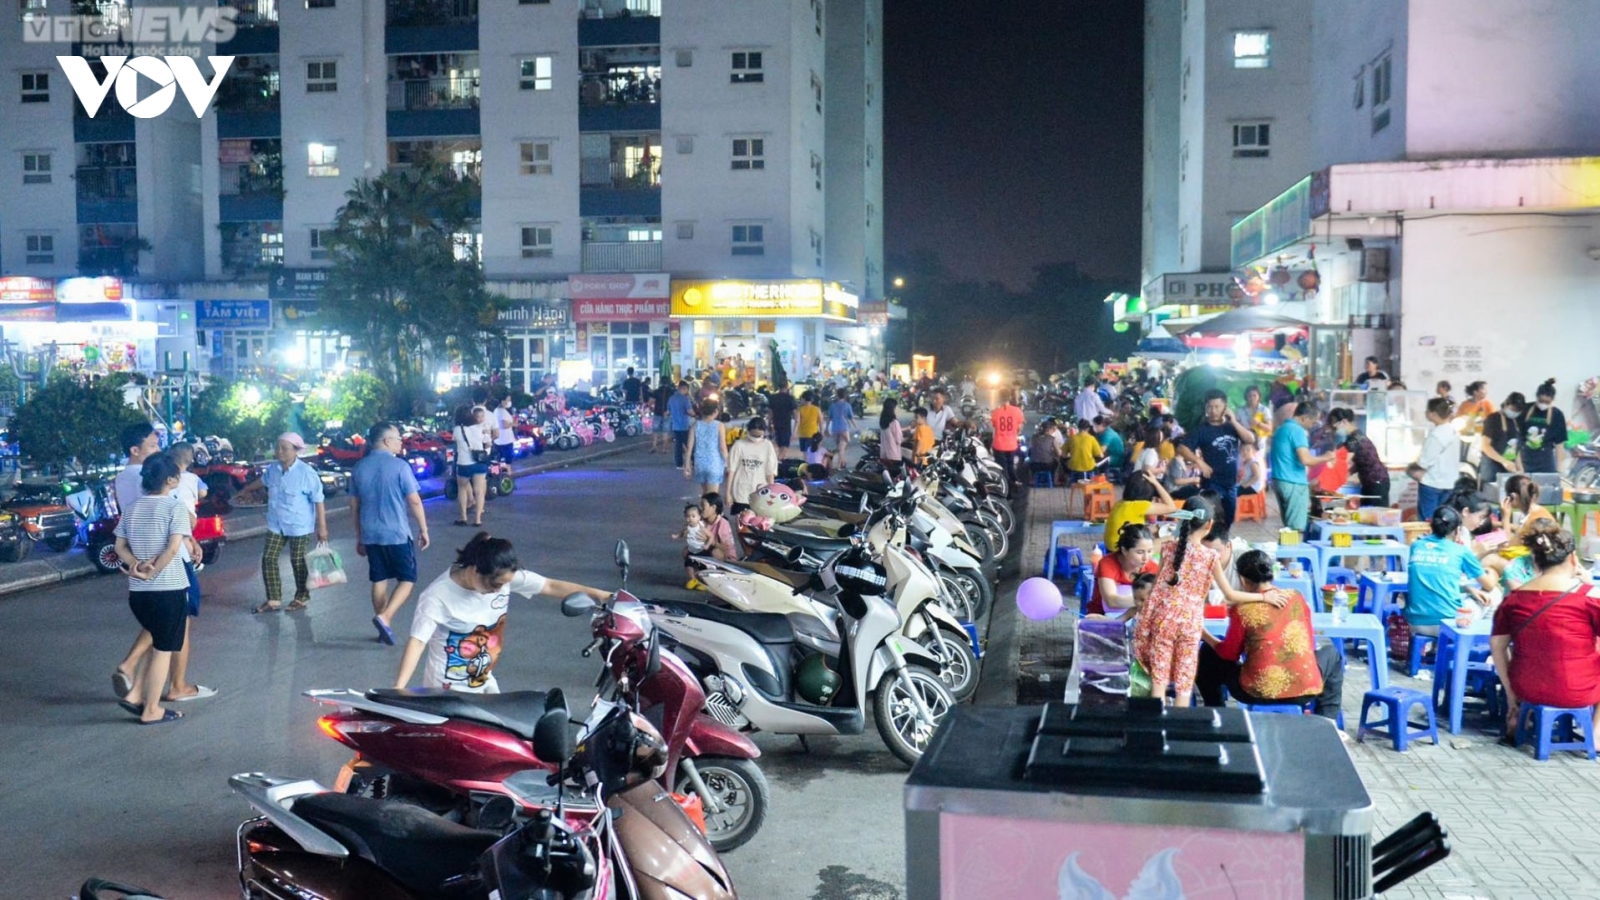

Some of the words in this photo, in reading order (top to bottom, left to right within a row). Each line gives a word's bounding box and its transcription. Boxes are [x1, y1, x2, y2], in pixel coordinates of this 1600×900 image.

[205, 306, 232, 317] TÂM
[235, 305, 260, 319] VIỆT
[498, 305, 529, 320] Minh
[580, 301, 594, 314] CỬA
[595, 302, 614, 314] HÀNG
[616, 303, 633, 316] THỰC
[634, 300, 655, 314] PHẨM
[999, 416, 1013, 432] 88
